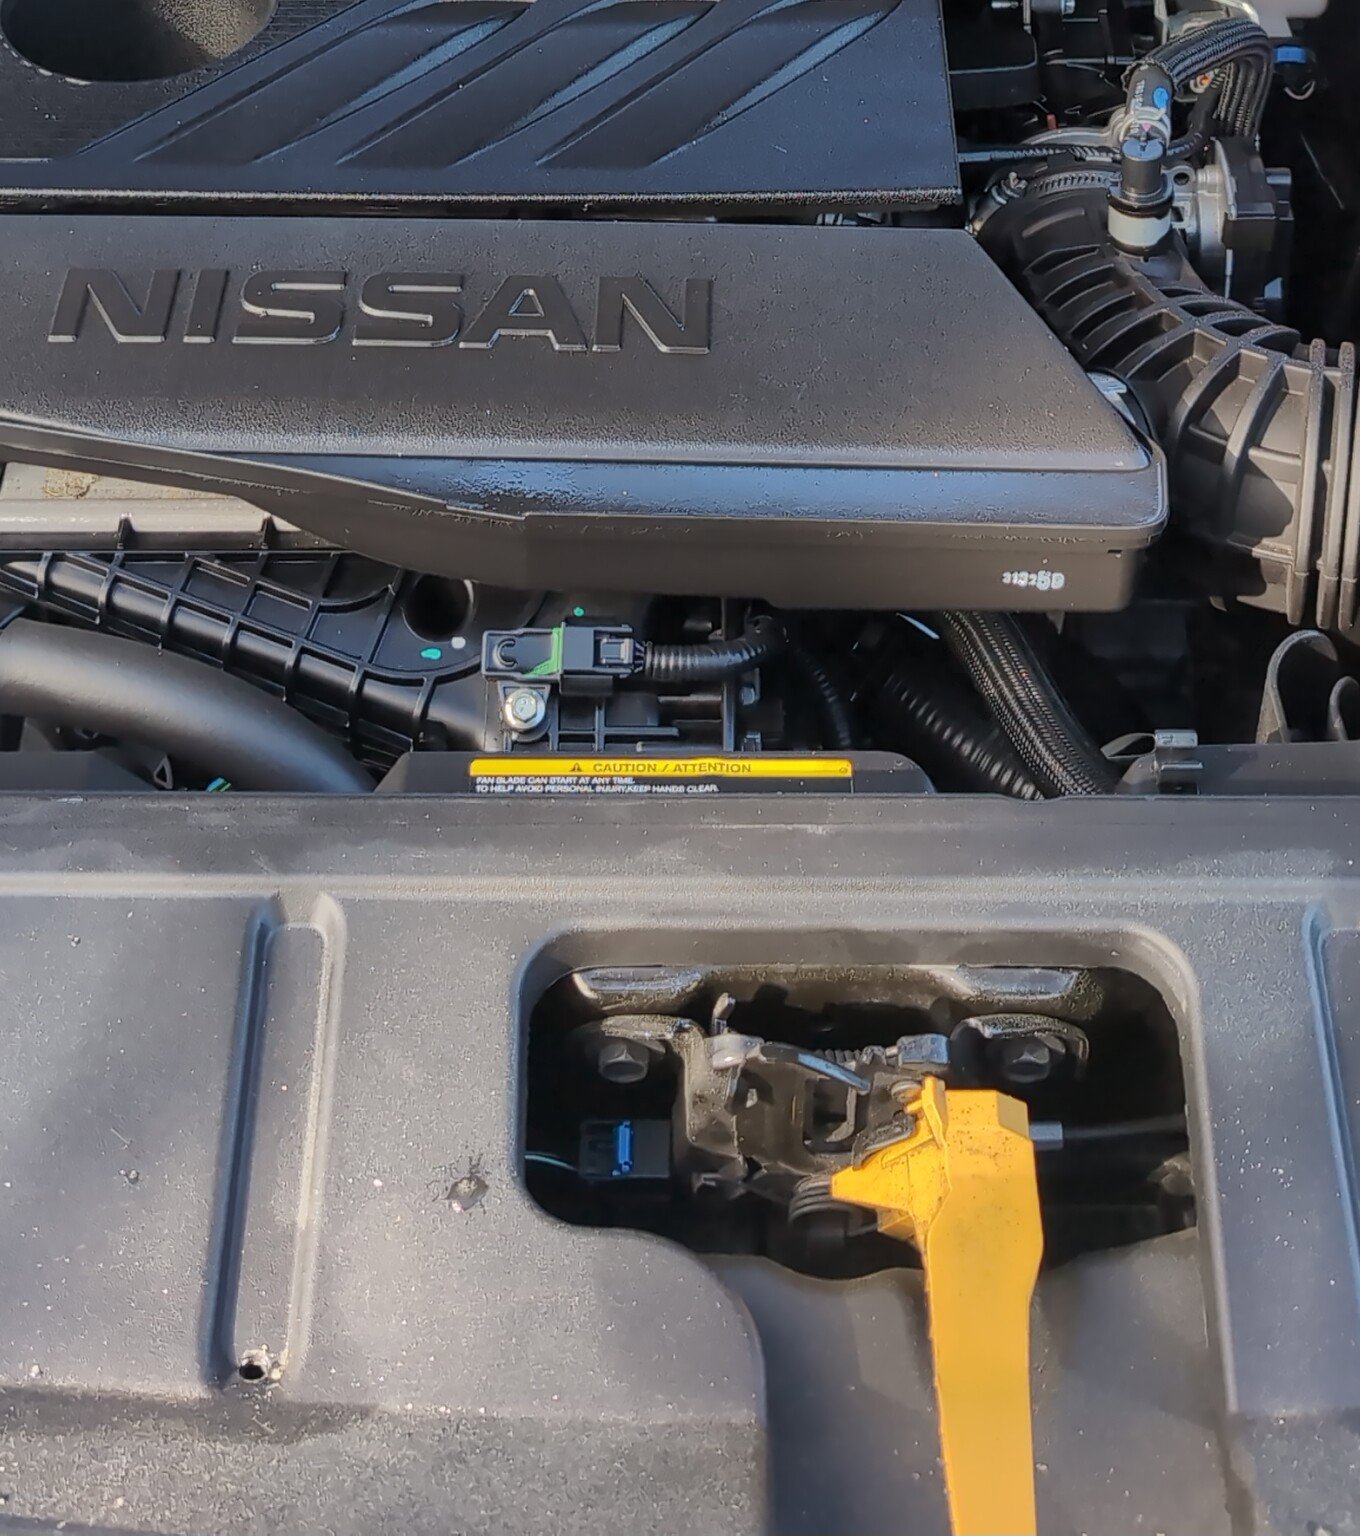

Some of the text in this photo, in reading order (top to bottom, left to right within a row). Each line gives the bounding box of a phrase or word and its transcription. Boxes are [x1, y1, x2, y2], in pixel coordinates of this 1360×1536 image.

[48, 268, 714, 354] NISSAN
[593, 763, 752, 773] CAUTION / ATTENTION
[476, 776, 635, 785] FAN BLADE CAN START AT ANY TIME.
[476, 784, 488, 793] TO
[490, 784, 514, 793] HELP
[515, 784, 543, 793] AVOID
[545, 784, 594, 793] PERSONAL
[653, 784, 684, 793] HANDS
